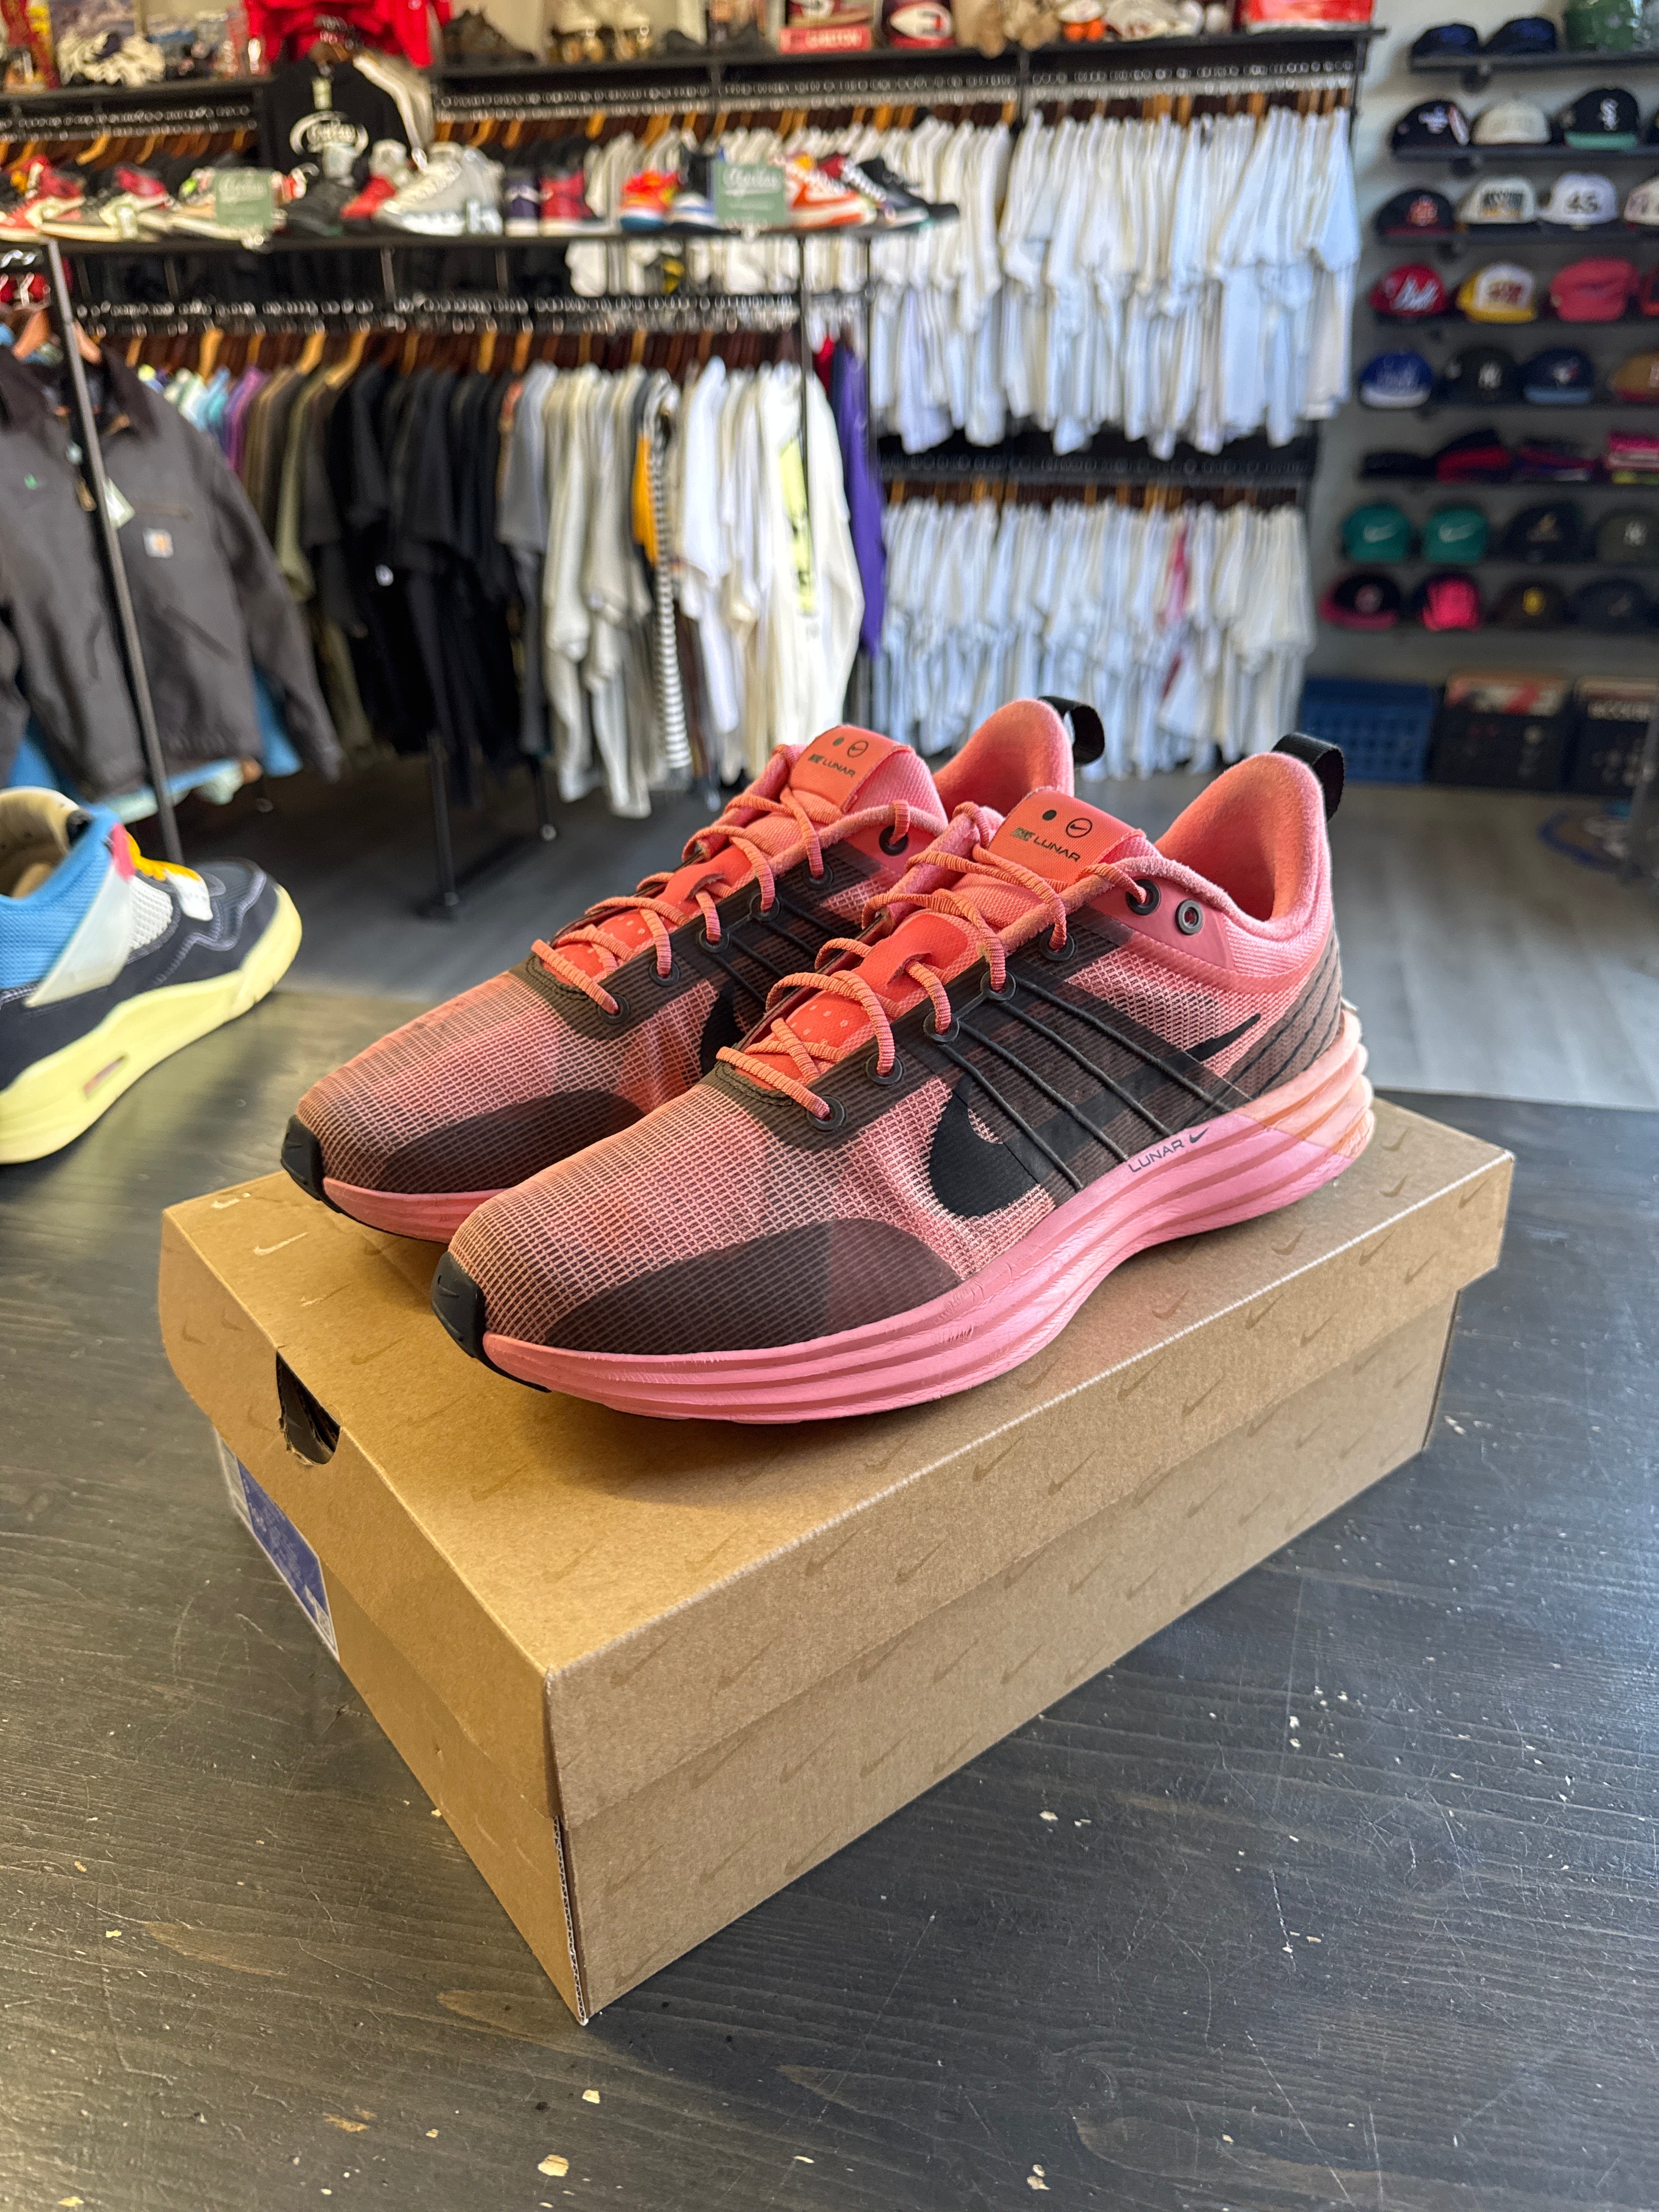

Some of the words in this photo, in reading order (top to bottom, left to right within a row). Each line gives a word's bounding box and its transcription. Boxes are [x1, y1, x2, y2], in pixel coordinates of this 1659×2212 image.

[822, 758, 856, 778] LUNAR
[1033, 836, 1080, 862] LUNAR
[1128, 1139, 1184, 1172] LUNAR
